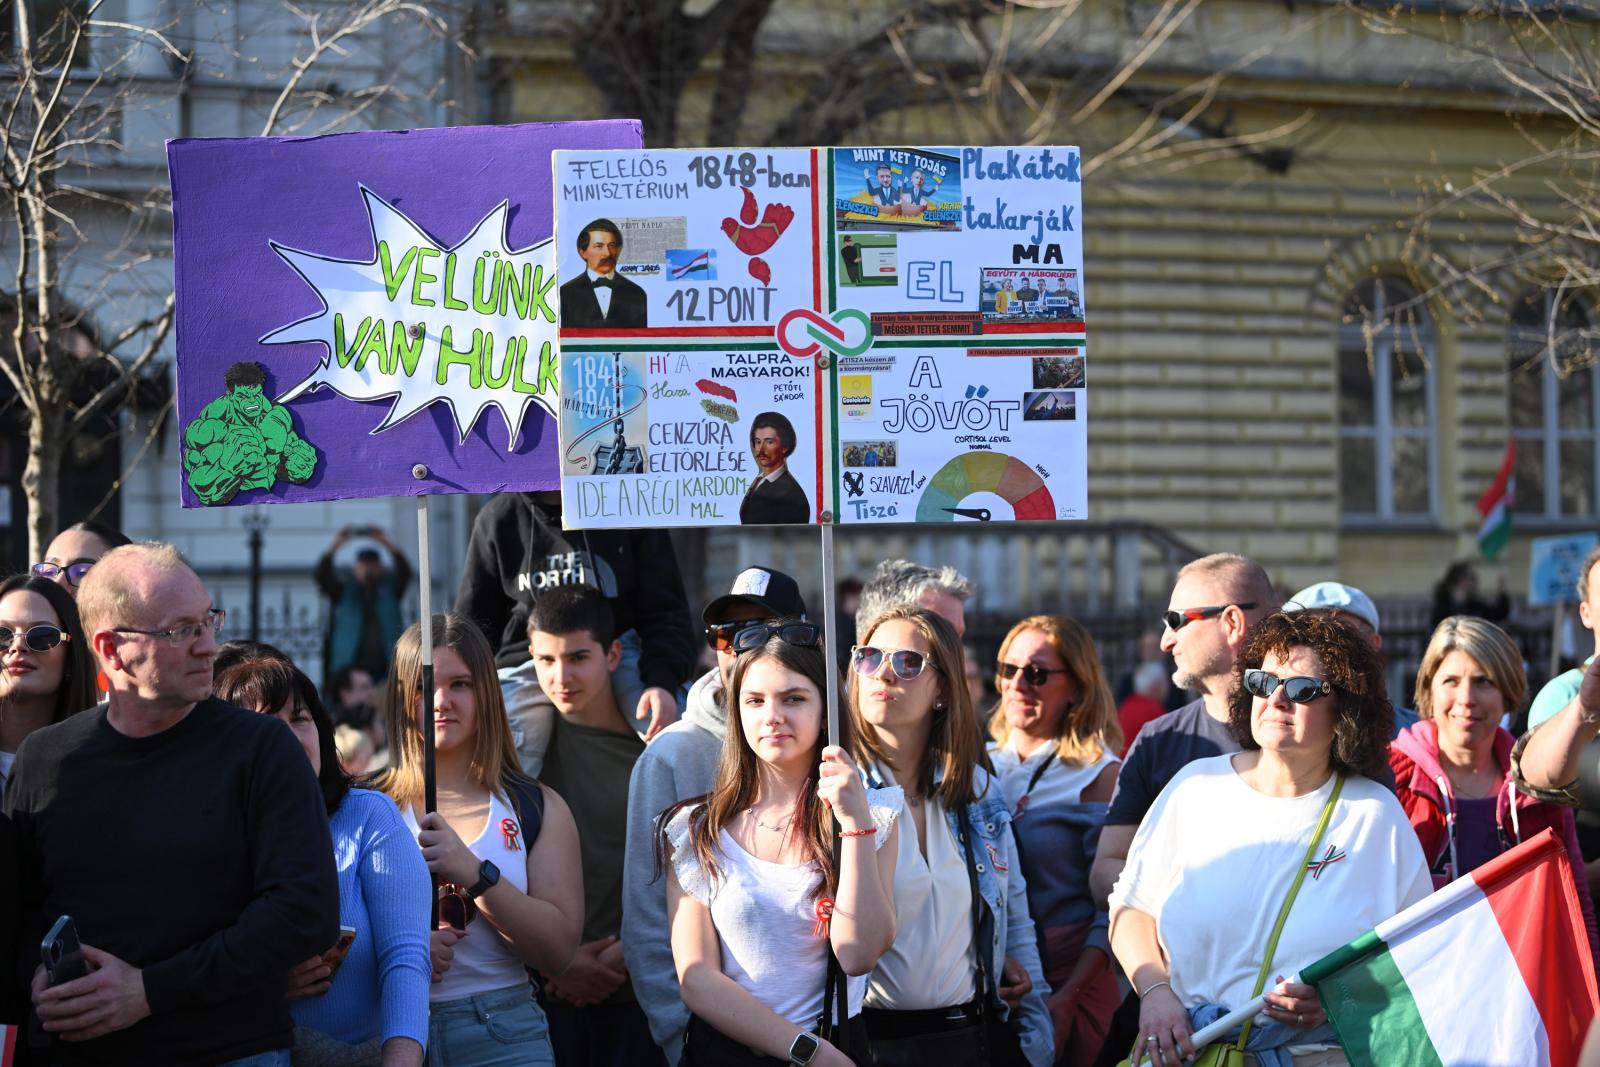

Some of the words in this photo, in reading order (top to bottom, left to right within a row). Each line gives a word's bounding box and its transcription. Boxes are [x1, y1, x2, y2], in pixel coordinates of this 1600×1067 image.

[568, 154, 667, 179] FELELŐS
[688, 152, 811, 189] 1848-ban
[853, 149, 885, 162] MINT
[914, 155, 947, 177] TOJÁS
[963, 148, 1081, 182] Plakátok
[563, 180, 689, 202] MINISZTÉRIUM
[964, 196, 1074, 245] takarják
[1012, 243, 1064, 265] MA
[379, 240, 557, 323] VELÜNK
[906, 260, 964, 303] EL
[666, 288, 706, 322] 12
[708, 286, 778, 323] PONT
[884, 322, 915, 335] MÉGSEM
[917, 323, 942, 334] TETTEK
[942, 323, 971, 334] SEMMIT
[334, 312, 426, 378] VAN
[436, 325, 559, 395] HULK
[725, 353, 792, 365] TALPRA
[711, 366, 811, 379] MAGYAROK!
[908, 355, 942, 389] A
[773, 392, 805, 403] SÁNDOR
[880, 384, 1021, 434] JÖVŐT
[648, 418, 734, 447] CENZÚRA
[954, 434, 987, 444] CORTISOL
[988, 434, 1012, 443] LEVEL
[649, 446, 749, 473] ELTÖRLÉSE
[1035, 464, 1051, 479] HIGH
[869, 469, 915, 495] SZAVAZZ!
[914, 475, 927, 490] LOW
[576, 480, 617, 519] IDE
[637, 475, 680, 517] RÉGI
[690, 502, 725, 519] MAL
[546, 551, 582, 570] THE
[518, 563, 585, 592] NORTH
